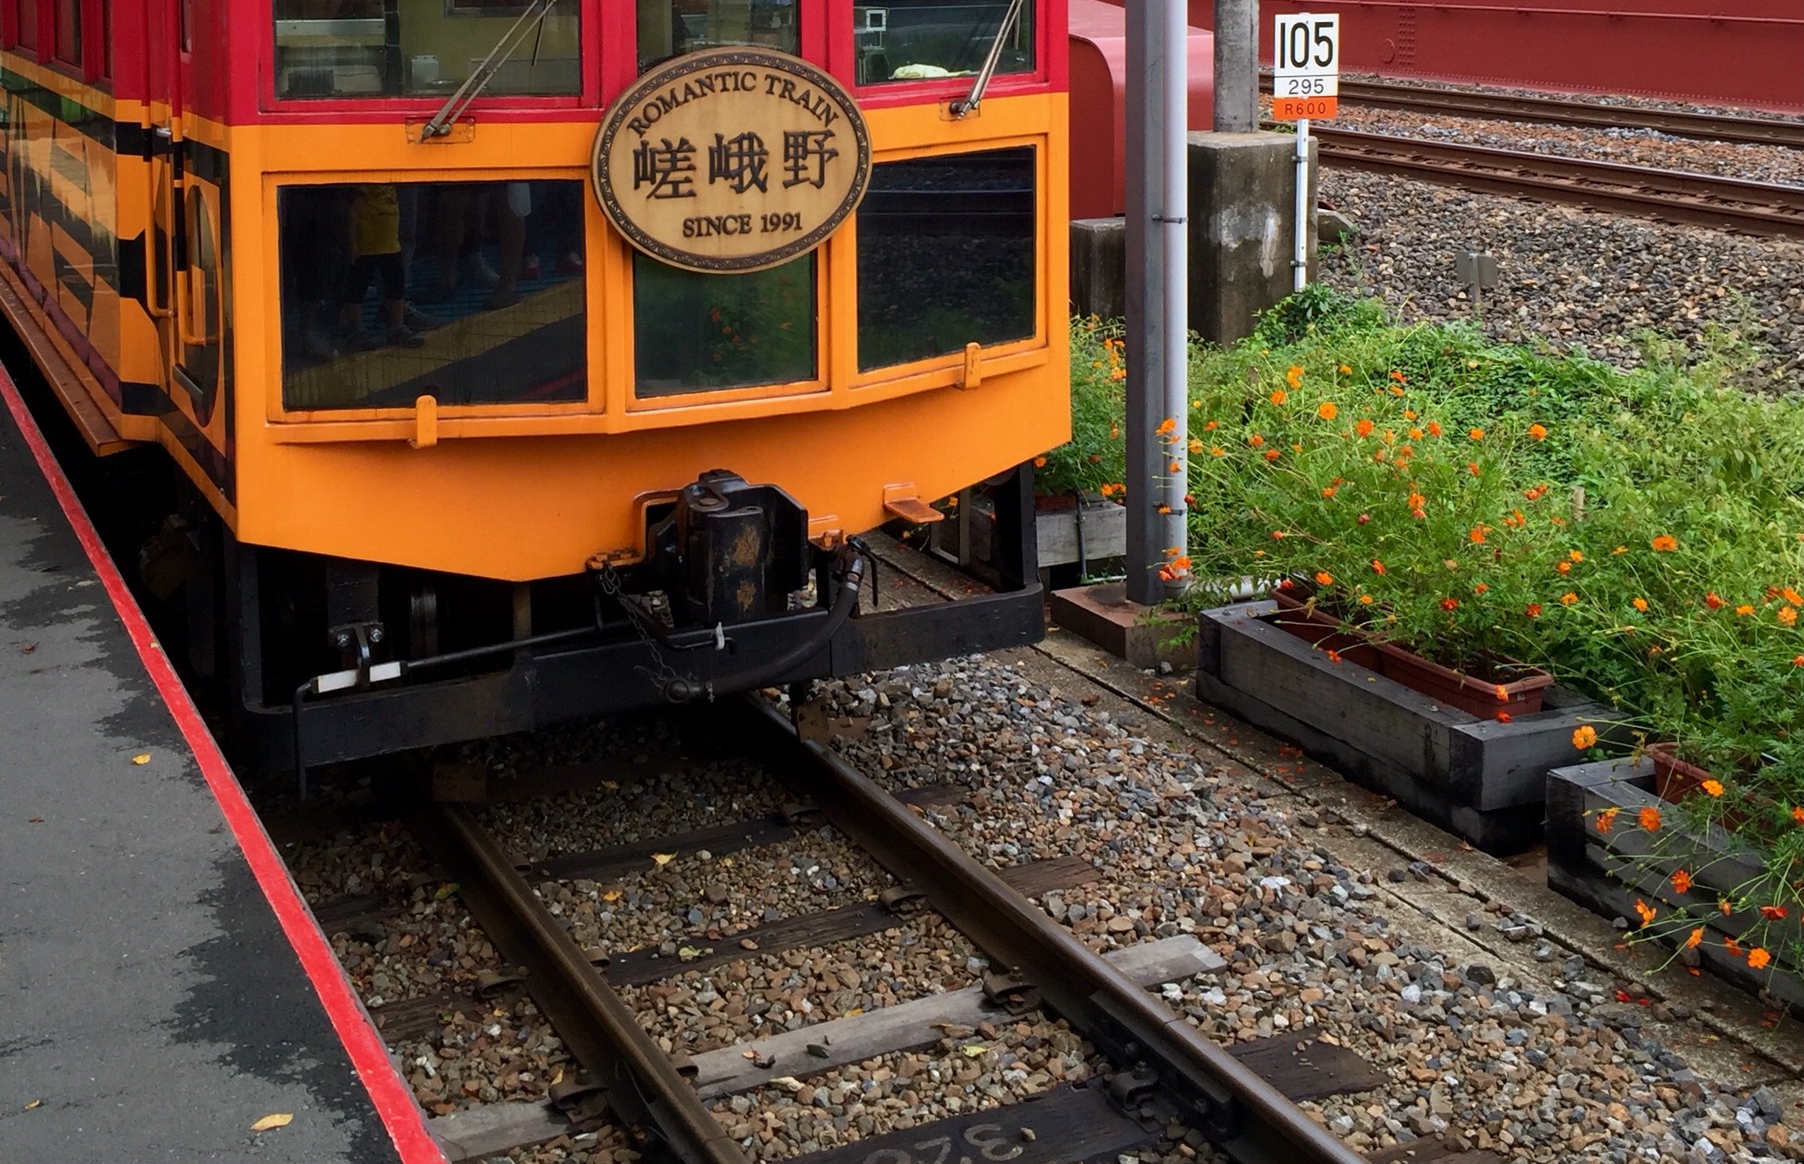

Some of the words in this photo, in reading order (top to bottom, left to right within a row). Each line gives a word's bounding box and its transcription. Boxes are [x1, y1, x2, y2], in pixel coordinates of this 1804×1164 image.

[1279, 21, 1334, 69] 105
[626, 71, 757, 138] ROMANTIC
[764, 73, 840, 129] TRAIN
[1288, 78, 1324, 95] 295
[1284, 102, 1326, 116] R600
[632, 128, 839, 200] 嵯峨野
[682, 213, 752, 238] SINCE
[760, 212, 803, 234] 1991
